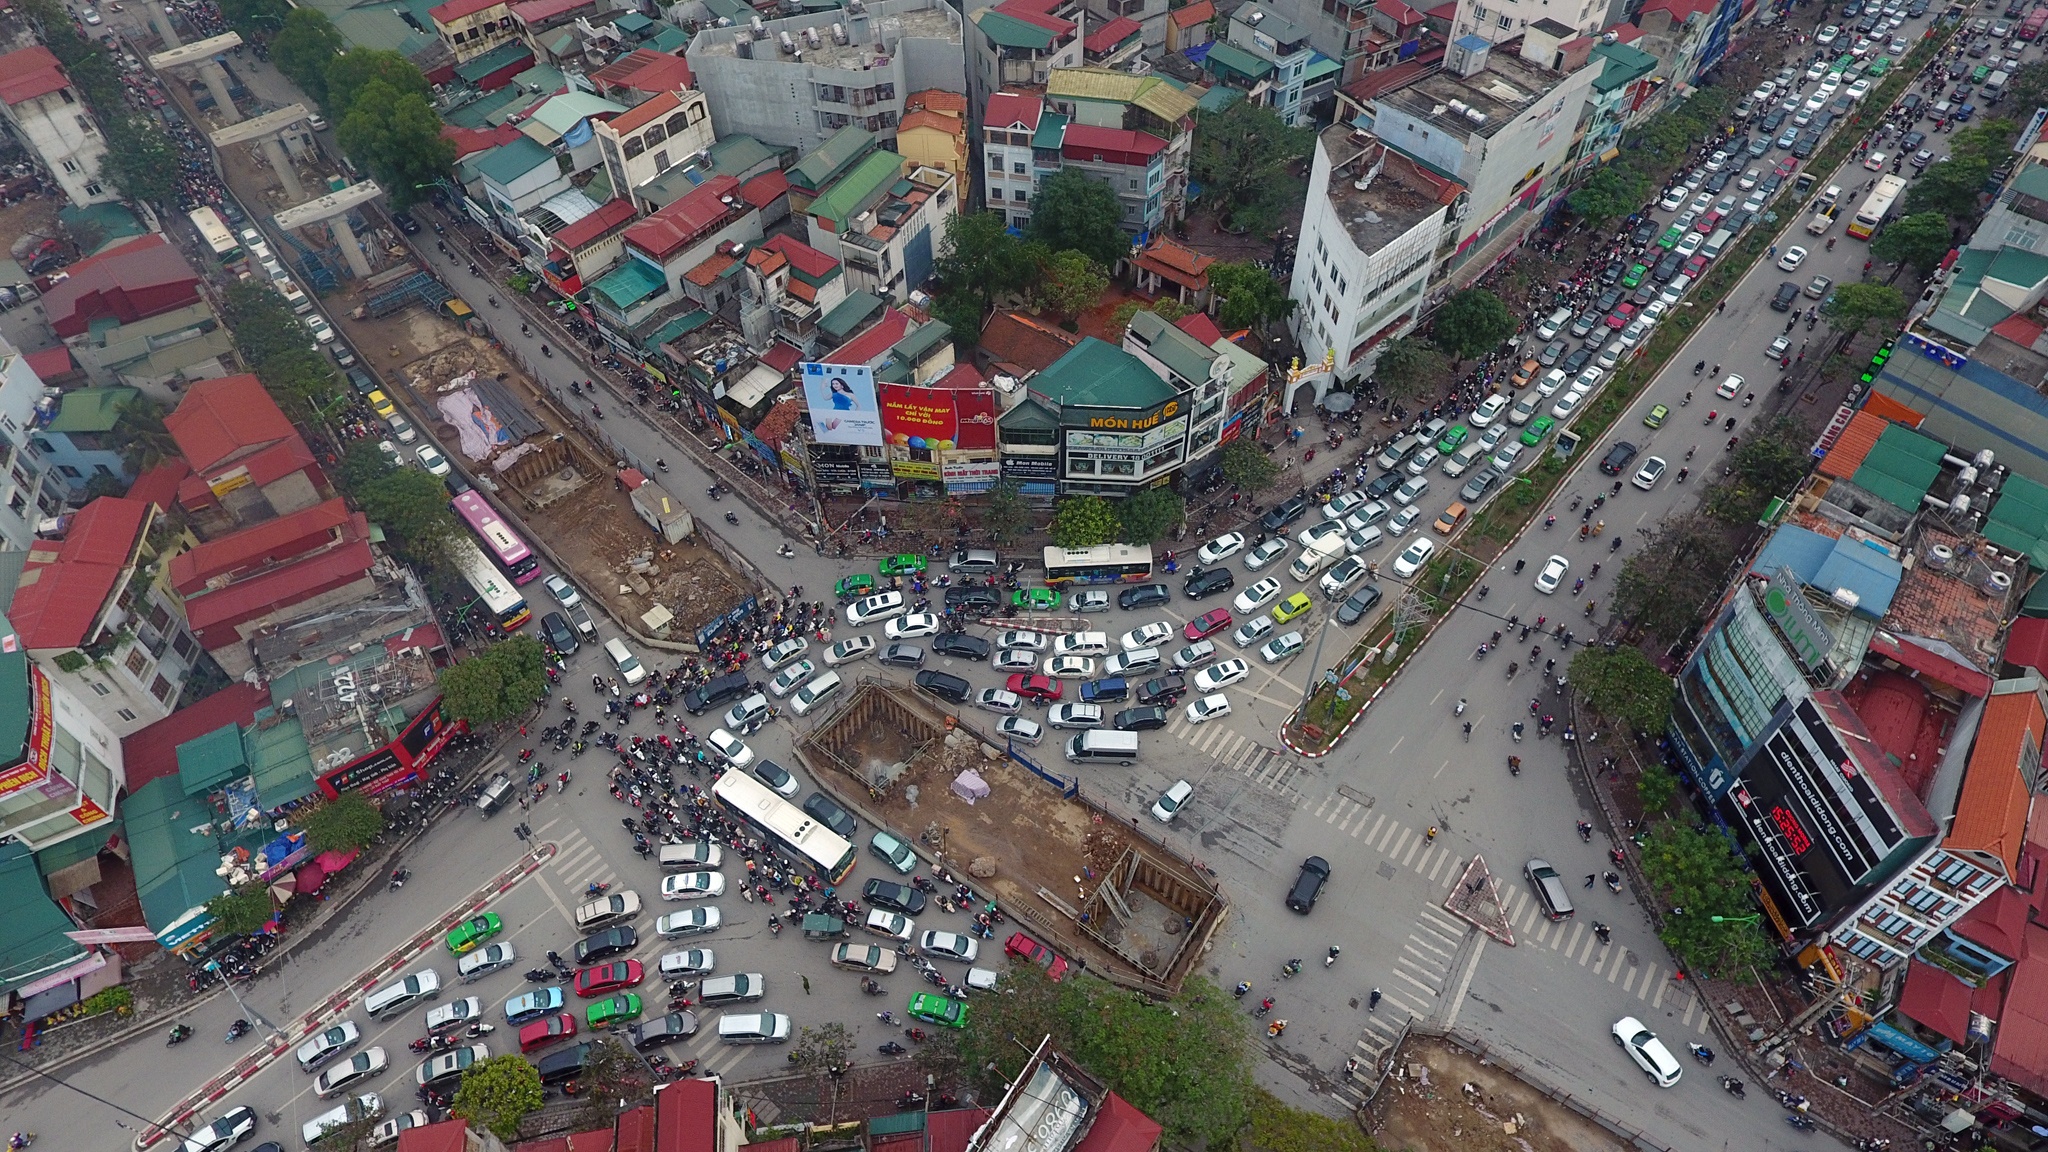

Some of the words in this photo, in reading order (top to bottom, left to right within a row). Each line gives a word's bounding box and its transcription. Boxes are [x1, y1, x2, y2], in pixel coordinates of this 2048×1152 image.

[896, 415, 921, 423] 10.000
[1090, 415, 1128, 429] MÓN
[1087, 453, 1129, 461] DELIVERY
[982, 468, 999, 476] TRANG
[1811, 621, 1830, 646] Minh
[316, 746, 355, 772] 422
[1680, 746, 1700, 778] STATION
[1698, 776, 1717, 805] COFFEE
[1780, 751, 1854, 861] dienthoaididong.com
[1771, 805, 1807, 856] 15:25:52
